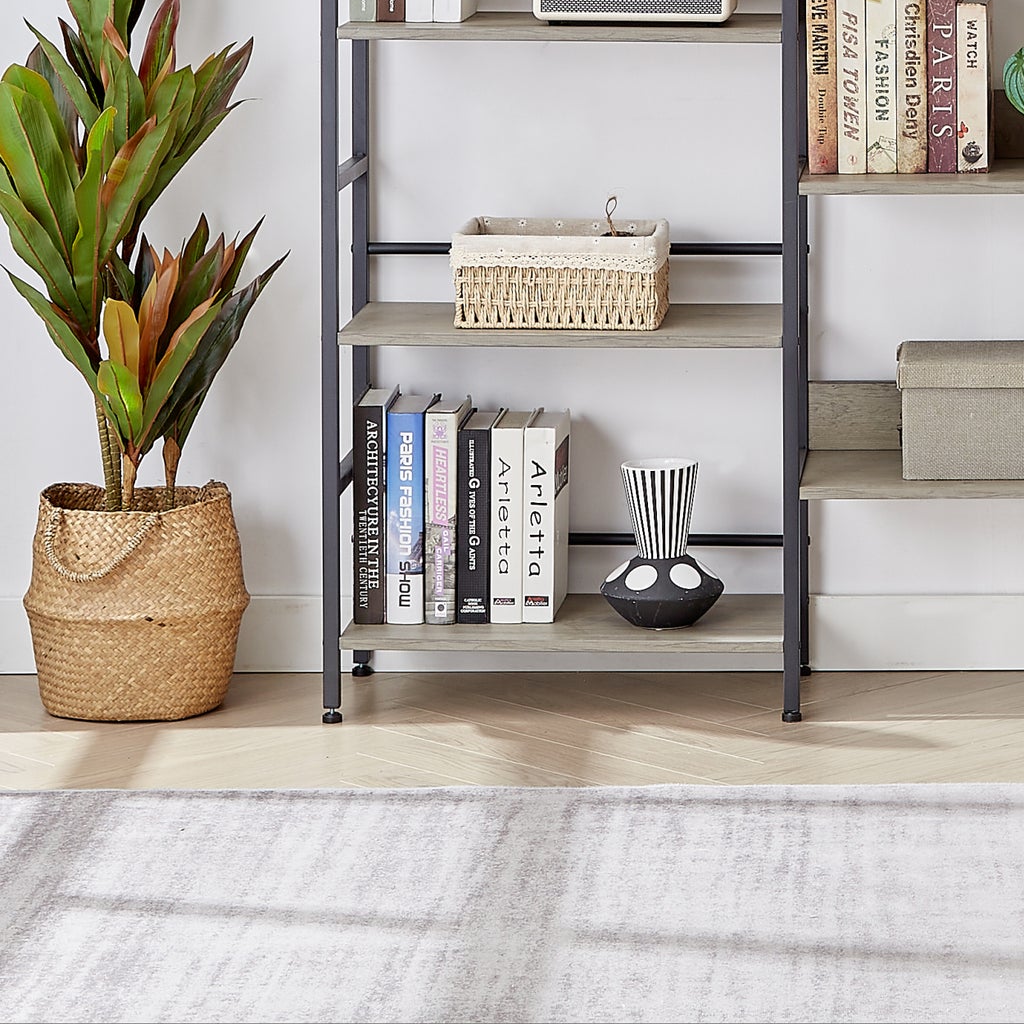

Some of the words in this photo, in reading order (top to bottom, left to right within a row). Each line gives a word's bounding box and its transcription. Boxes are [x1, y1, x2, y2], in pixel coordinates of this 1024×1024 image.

[842, 10, 858, 59] PISA
[904, 3, 921, 88] Chrisdien
[966, 20, 978, 69] WATCH
[842, 68, 860, 141] TOWEN
[875, 39, 890, 121] FASHION
[932, 23, 953, 138] PARIS
[902, 94, 921, 140] Deny
[366, 420, 379, 536] ARCHITECYURE
[434, 448, 448, 521] HEARTLESS
[358, 510, 367, 564] TWENTIETH
[368, 540, 379, 554] IN
[498, 457, 512, 575] Arletta
[528, 460, 548, 577] Arletta
[359, 566, 368, 609] CENTURY
[367, 558, 379, 589] THE
[398, 561, 411, 608] SHOW
